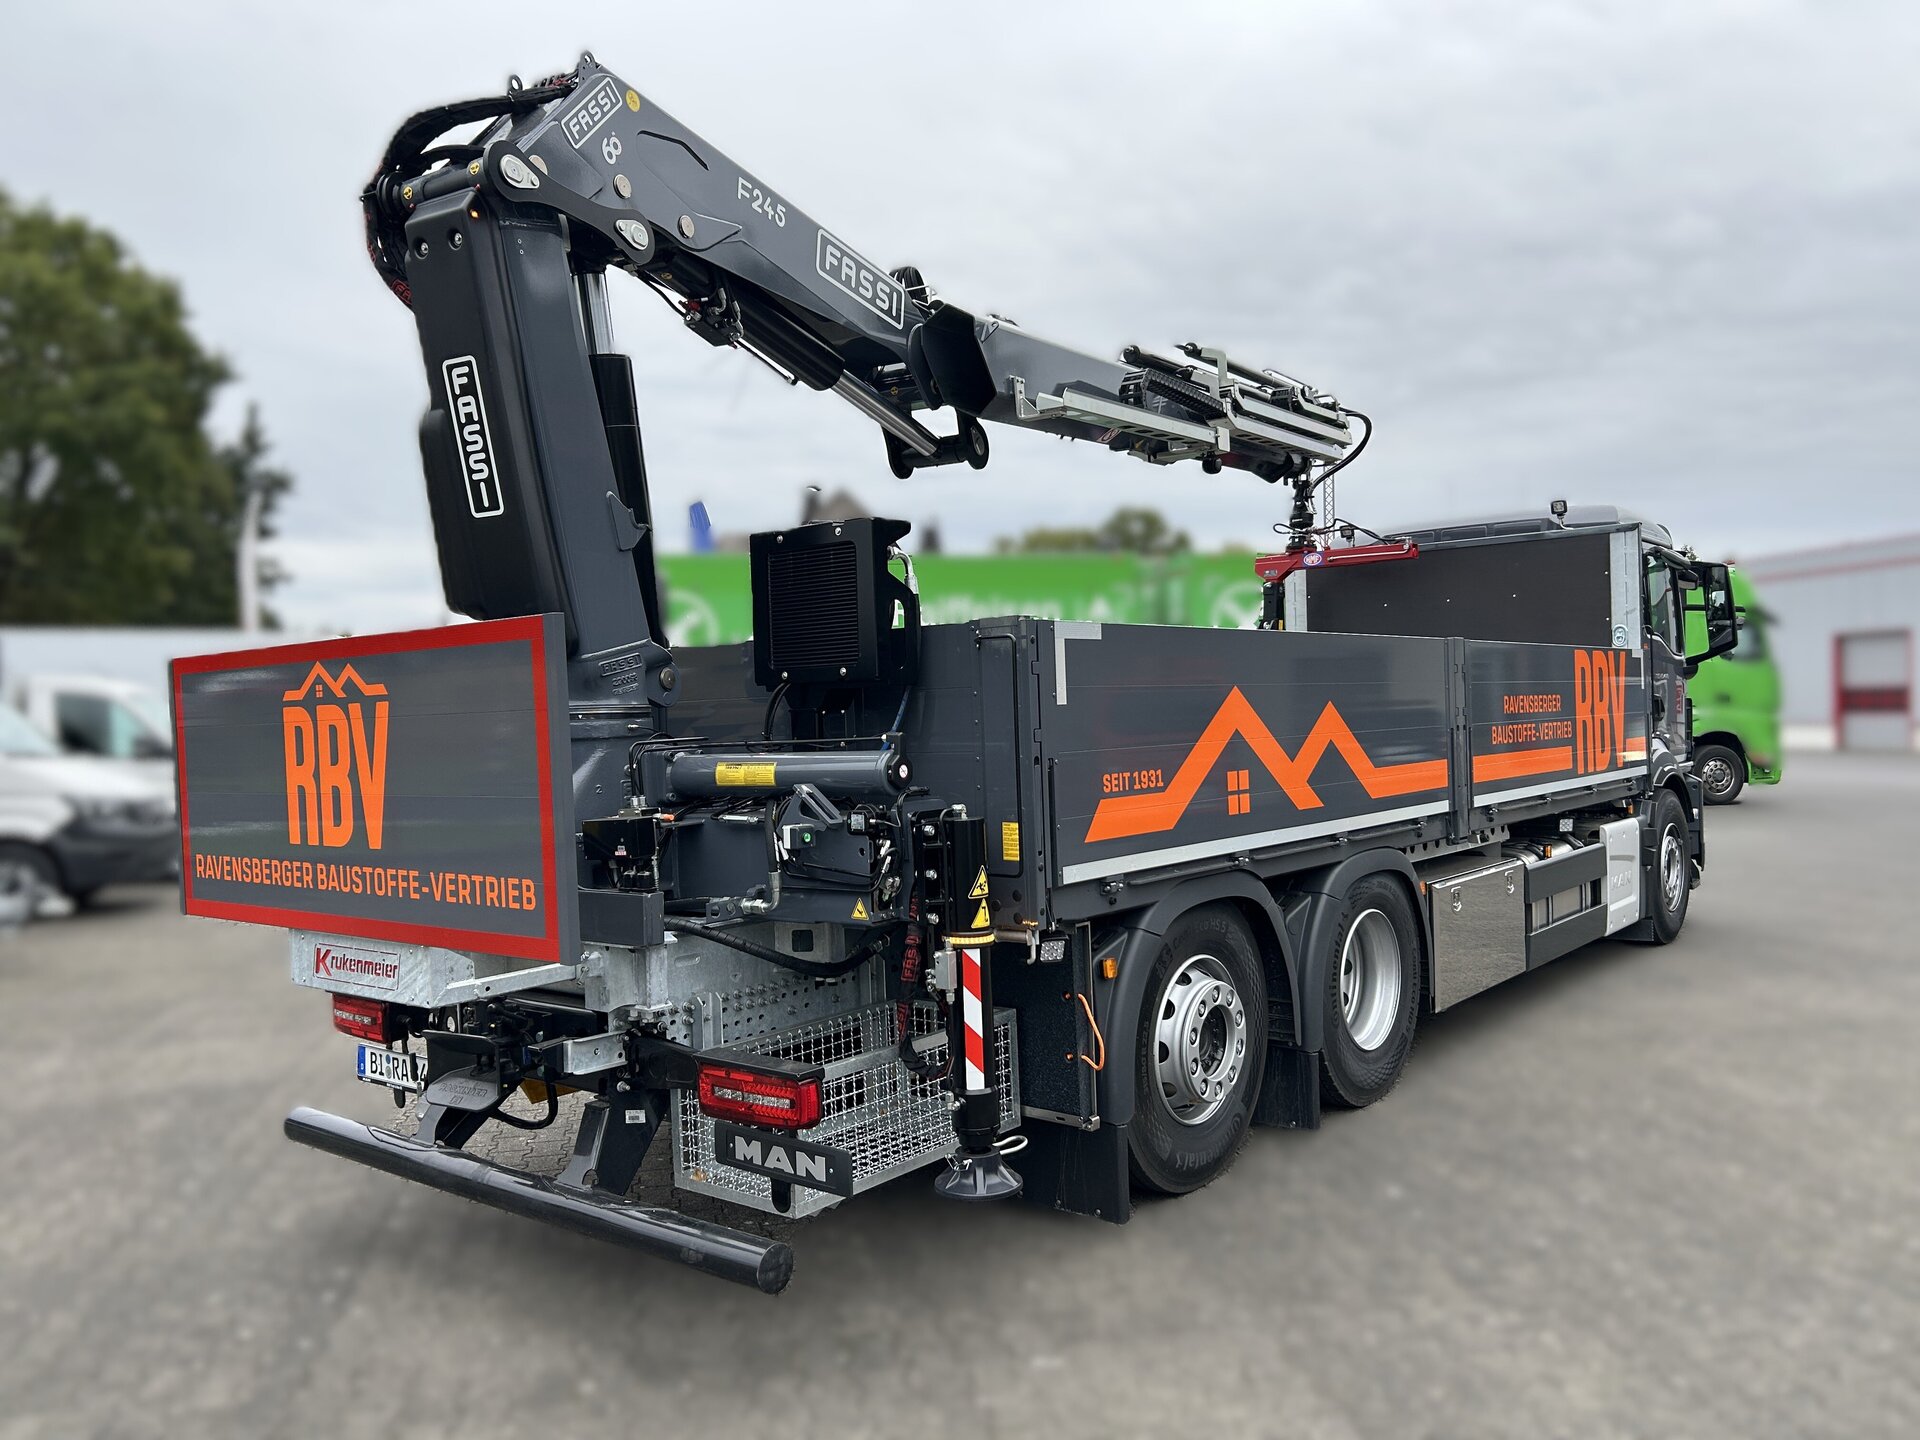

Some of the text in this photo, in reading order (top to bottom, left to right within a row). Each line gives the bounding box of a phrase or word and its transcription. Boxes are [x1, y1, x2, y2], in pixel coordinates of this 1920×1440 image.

[569, 86, 616, 140] FASSI
[737, 176, 786, 228] F245
[825, 244, 897, 317] FASSI
[451, 365, 490, 508] FASSI
[1503, 694, 1562, 714] RAVENSBERGER
[1574, 649, 1626, 775] RBV
[1491, 721, 1573, 745] BAUSTOFFE-VERTRIEB
[282, 701, 389, 850] RBV
[1102, 769, 1164, 793] SEIT 1931
[196, 853, 537, 911] RAVENSBERGER BAUSTOFFE-VERTRIEB
[315, 947, 398, 979] Krukenmeier
[392, 1057, 409, 1082] RA
[734, 1135, 826, 1182] MAN
